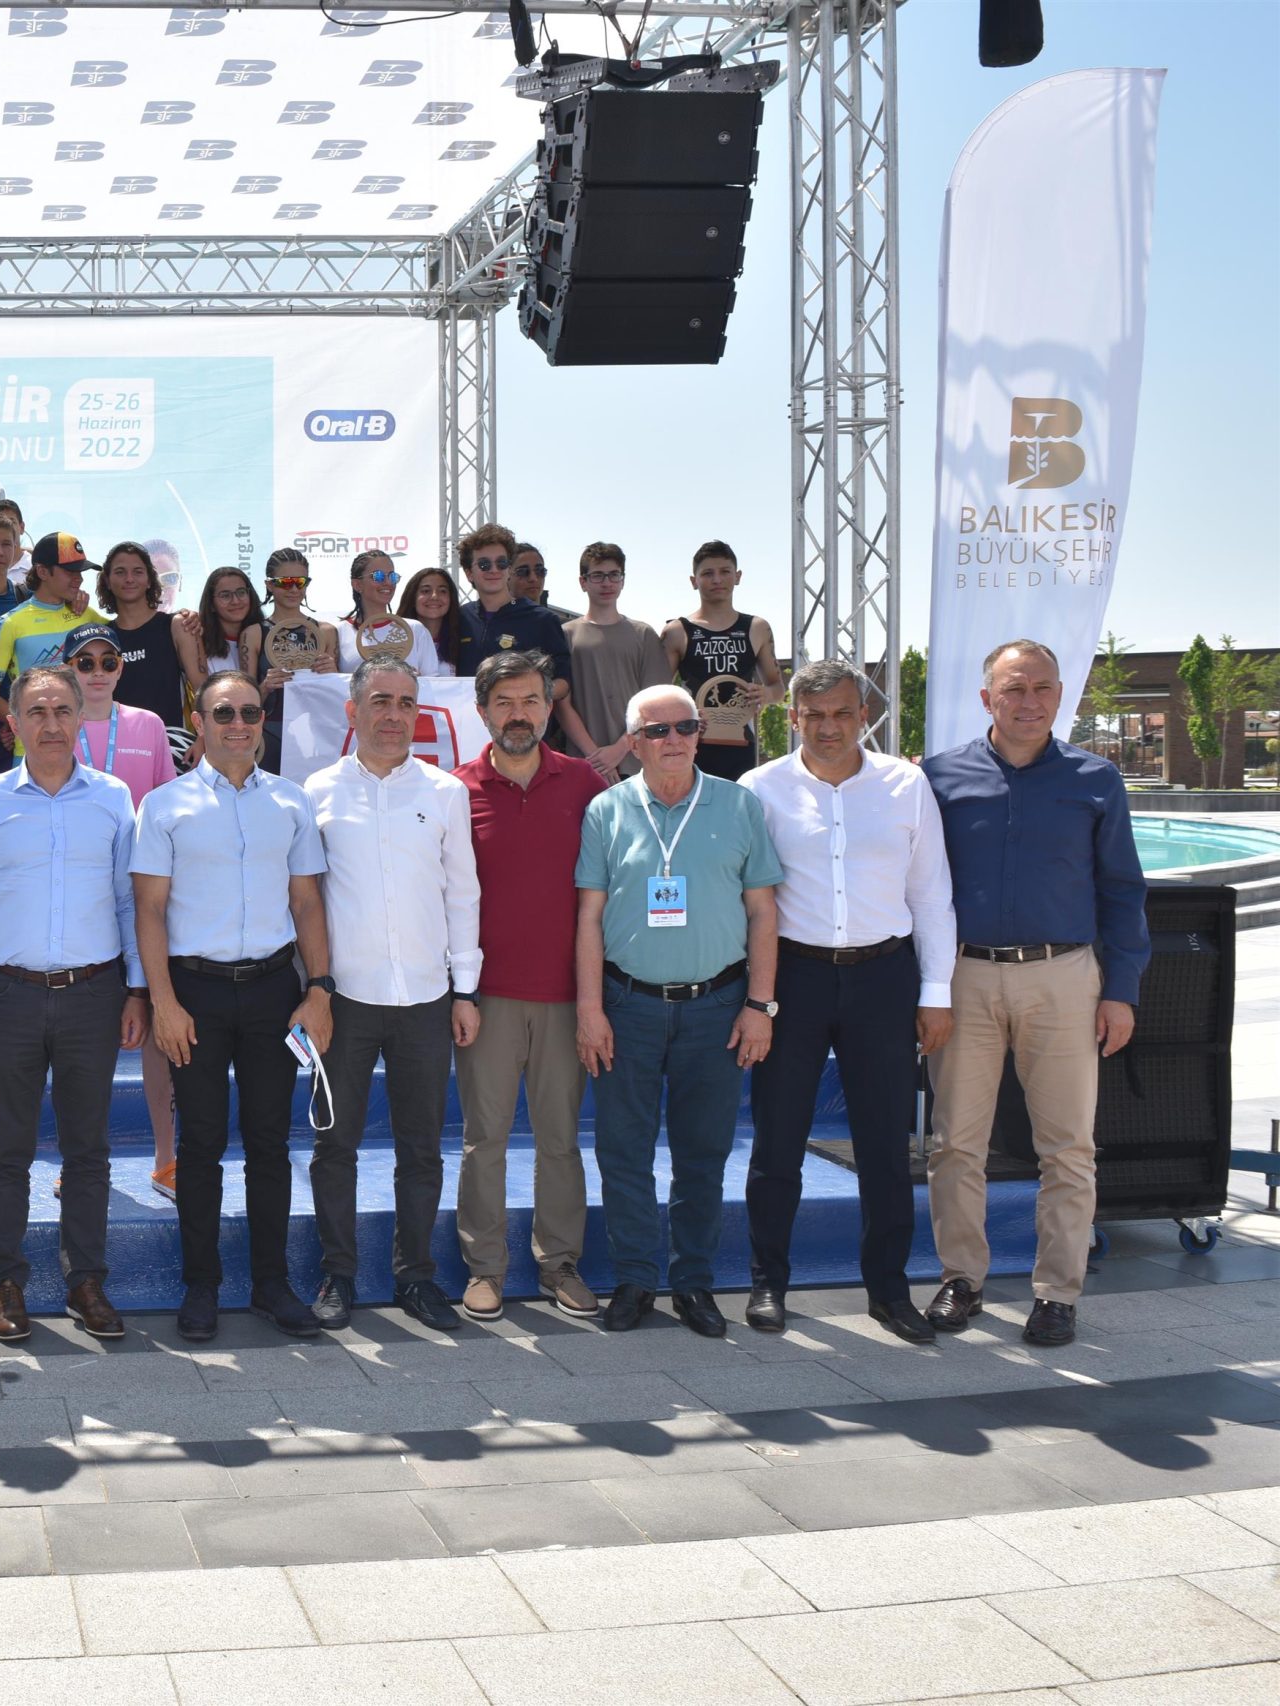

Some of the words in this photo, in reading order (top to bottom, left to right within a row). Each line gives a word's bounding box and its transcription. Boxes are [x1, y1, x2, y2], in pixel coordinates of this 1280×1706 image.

[79, 393, 140, 410] 25-26
[78, 416, 141, 430] Haziran
[310, 415, 388, 436] Oral-B
[79, 437, 140, 457] 2022
[959, 498, 1117, 534] BALIKESİR
[957, 537, 1112, 568] BÜYÜKŞEHİR
[121, 649, 145, 663] RUN
[694, 639, 747, 656] AZIZOGLU
[704, 655, 738, 673] TUR
